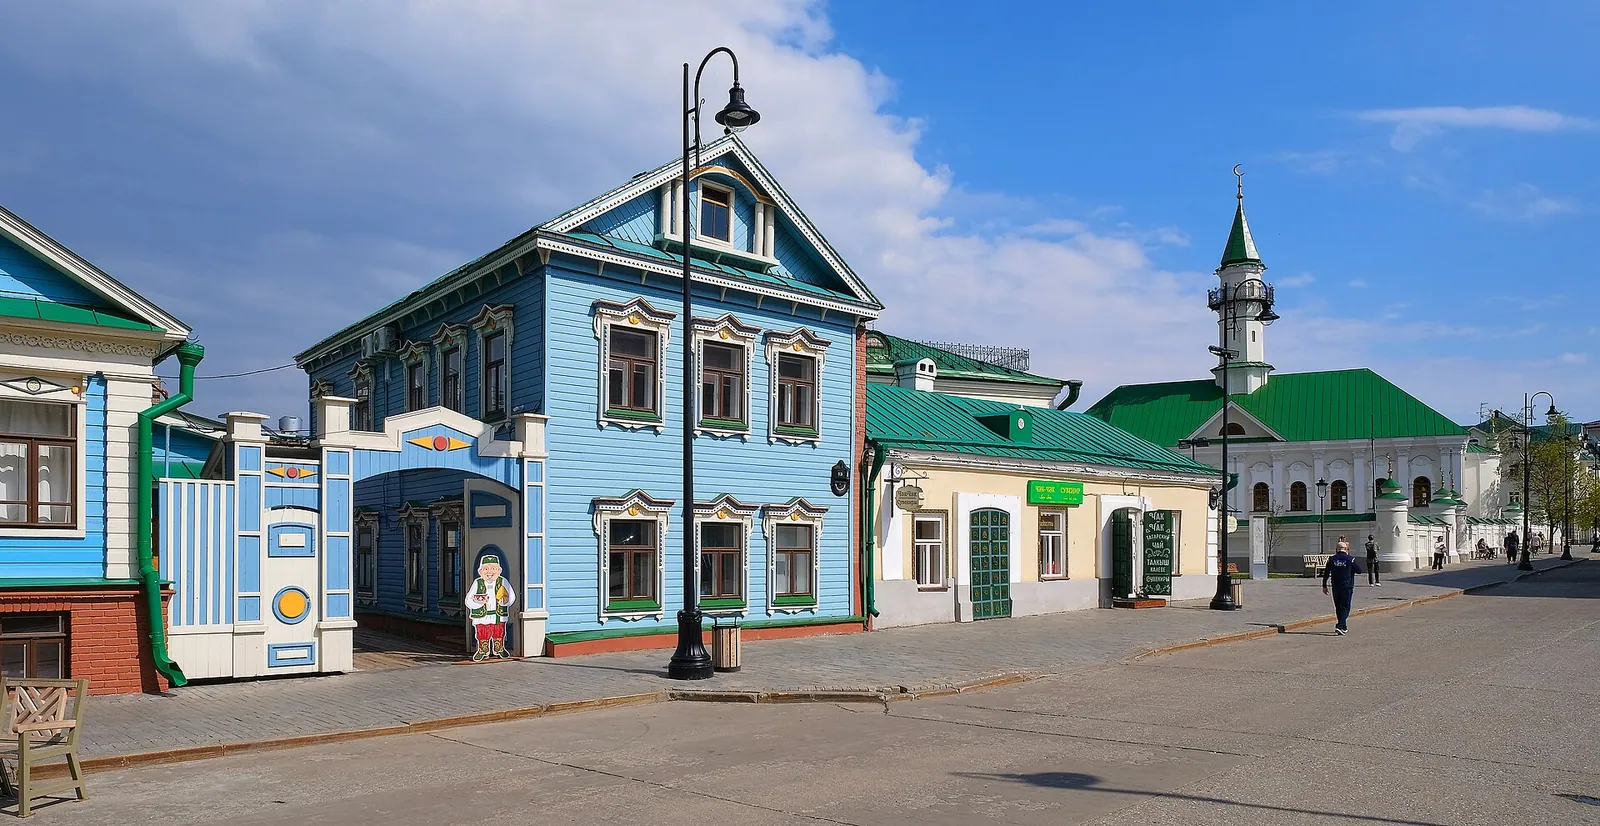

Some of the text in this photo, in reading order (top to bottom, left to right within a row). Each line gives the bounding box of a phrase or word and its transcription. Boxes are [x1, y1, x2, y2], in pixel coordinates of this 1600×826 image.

[1148, 511, 1165, 521] ЧАК
[1148, 522, 1165, 532] ЧАК
[1146, 533, 1170, 541] ТАТАРСКИЙ
[1152, 540, 1164, 549] ЧАЙ
